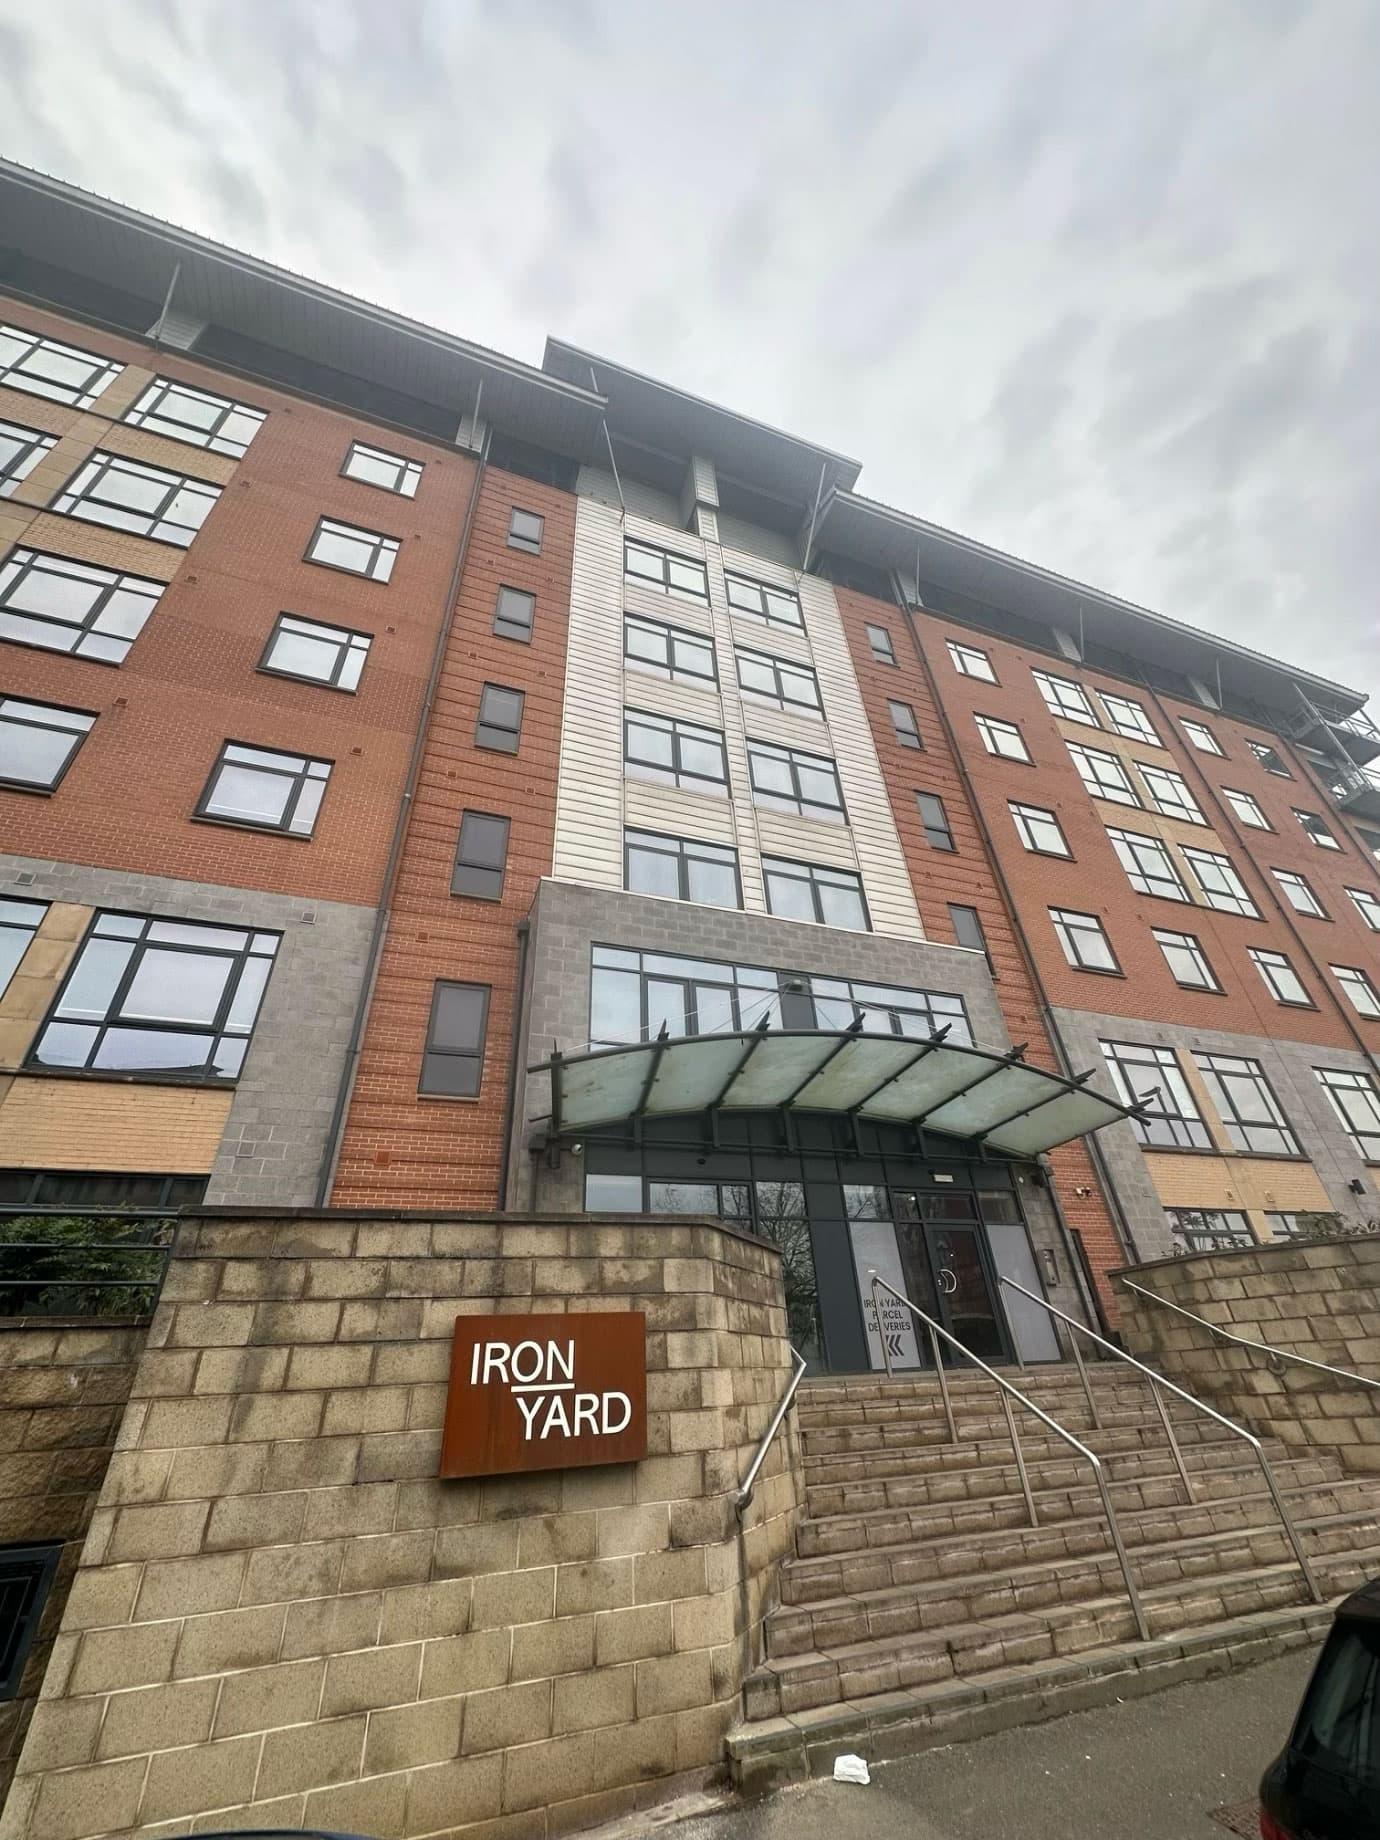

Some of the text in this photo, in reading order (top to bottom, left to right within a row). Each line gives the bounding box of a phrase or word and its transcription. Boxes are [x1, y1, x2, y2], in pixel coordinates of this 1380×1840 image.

[868, 1321, 911, 1332] DEVERIES
[872, 1310, 903, 1319] PRCEL
[470, 1340, 575, 1385] IRON
[516, 1391, 632, 1440] YARD
